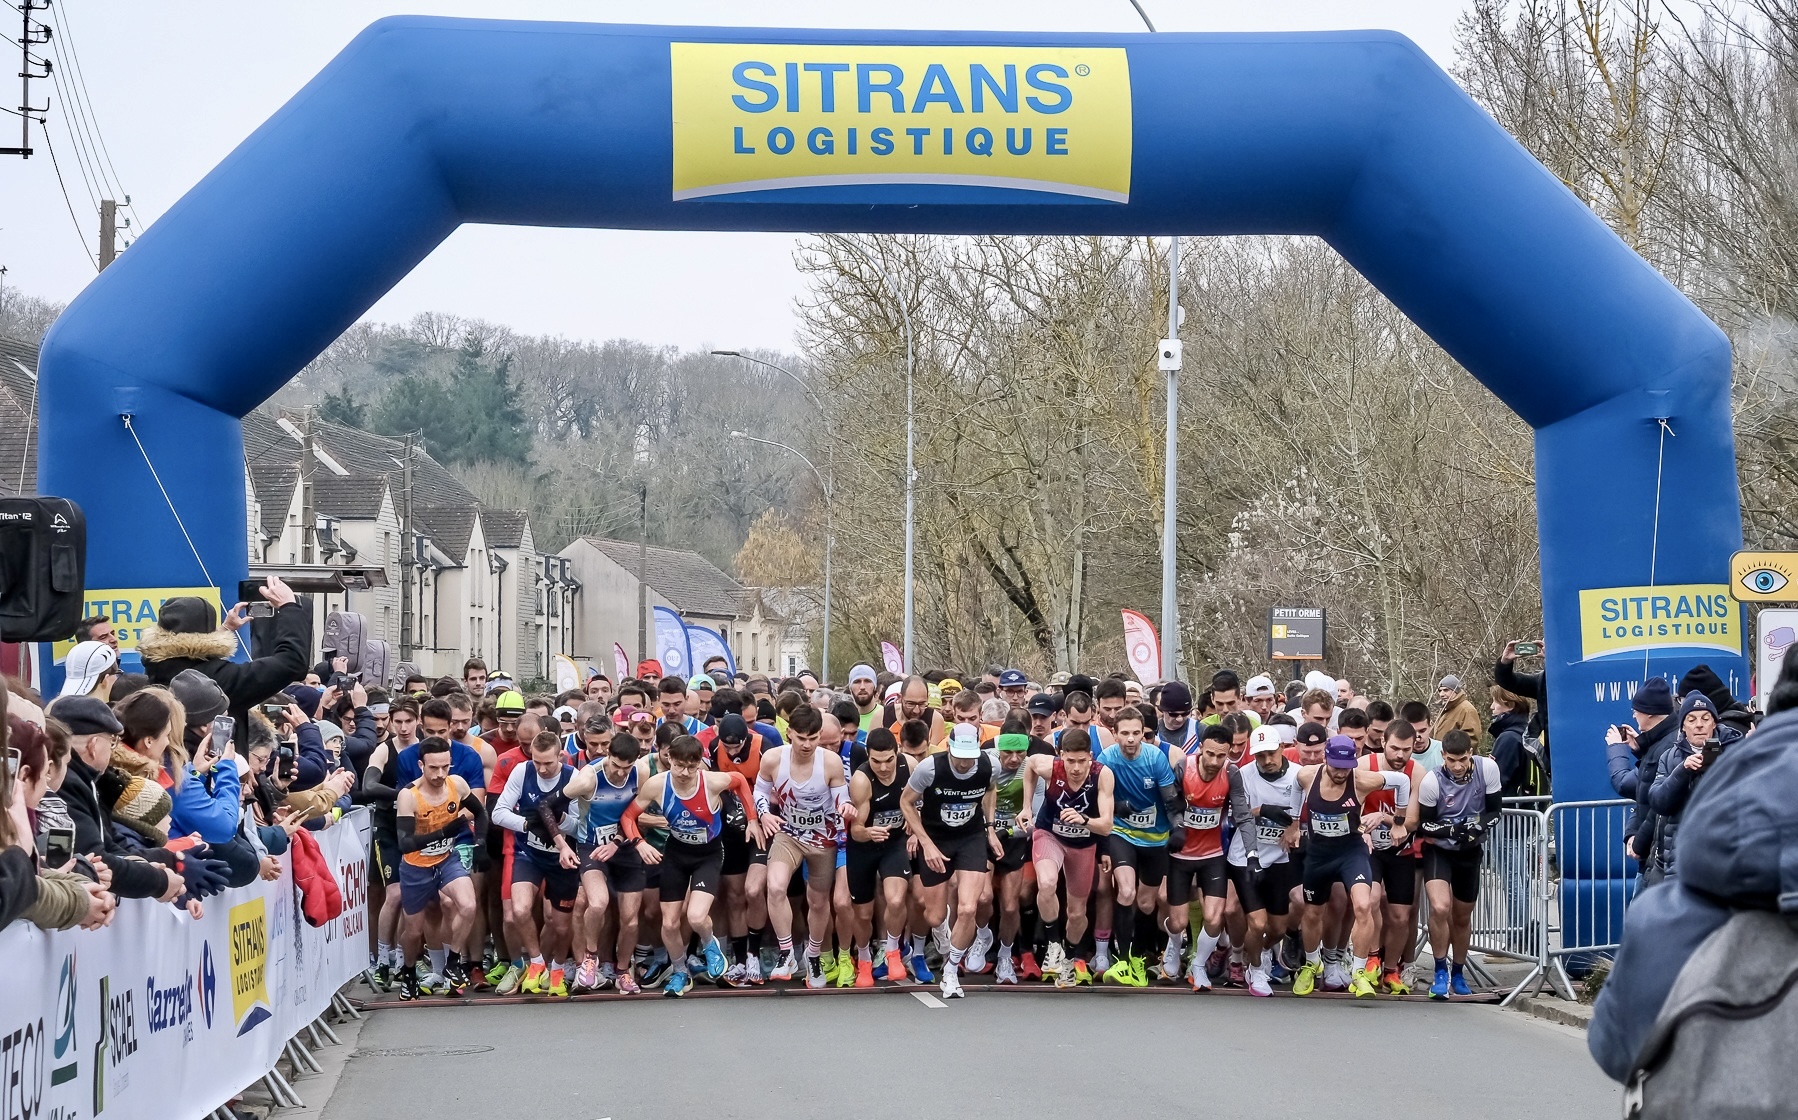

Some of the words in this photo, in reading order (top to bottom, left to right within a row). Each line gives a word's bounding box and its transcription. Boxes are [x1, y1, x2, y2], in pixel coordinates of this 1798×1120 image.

[733, 126, 1070, 157] LOGISTIQUE
[84, 599, 167, 623] ITRA
[1274, 609, 1297, 617] PETIT
[1298, 609, 1321, 617] ORME
[1601, 594, 1728, 622] SITRANS
[1275, 625, 1284, 639] 3
[1602, 623, 1728, 639] LOGISTIQUE
[1258, 733, 1265, 742] B
[791, 814, 823, 826] 1098
[946, 811, 971, 820] 1344
[1189, 814, 1215, 823] 4014
[1059, 825, 1085, 834] 1207
[1260, 827, 1285, 838] 1252
[1319, 822, 1340, 830] 812
[146, 968, 193, 1034] Carre
[110, 988, 138, 1068] SCAEL
[0, 1016, 45, 1120] TECO
